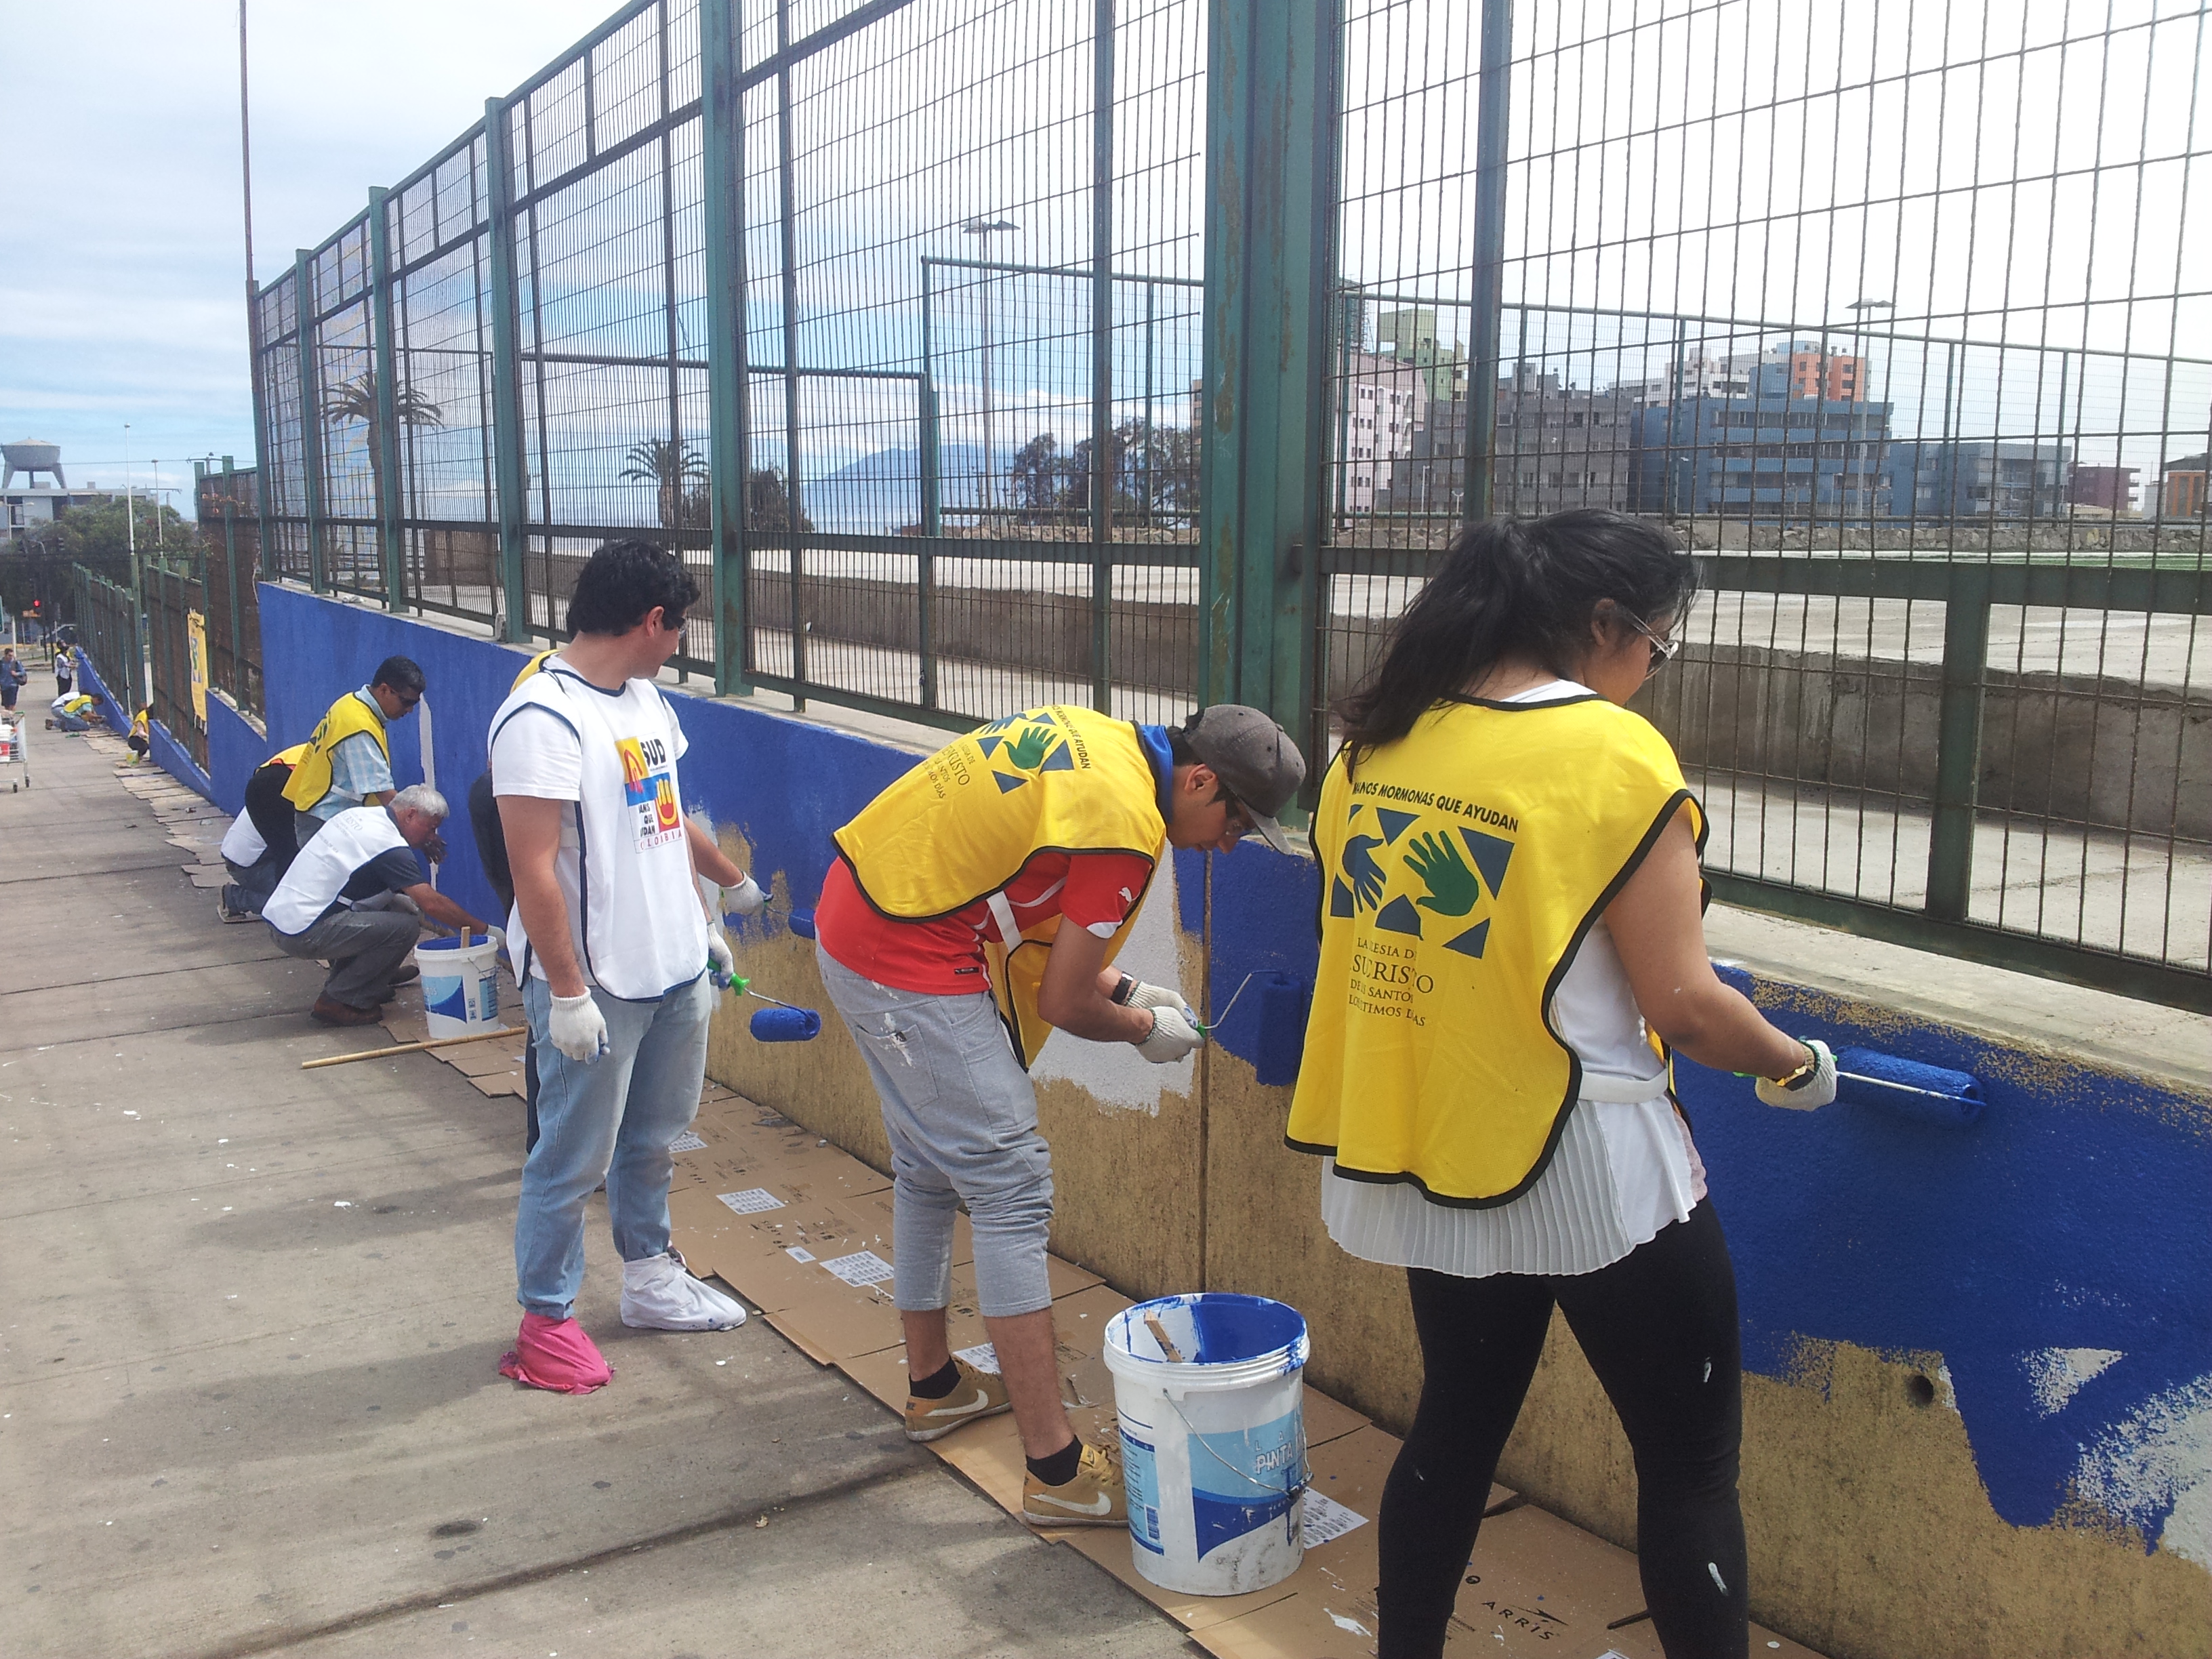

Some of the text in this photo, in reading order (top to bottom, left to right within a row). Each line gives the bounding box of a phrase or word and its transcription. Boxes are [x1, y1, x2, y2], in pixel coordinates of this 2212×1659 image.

[640, 739, 666, 767] SUD
[1073, 739, 1091, 769] AYUDAN
[934, 782, 946, 798] DÍAS
[1377, 783, 1435, 806] MORMONAS
[1436, 795, 1462, 814] QUE
[1462, 803, 1519, 833] AYUDAN
[1481, 1601, 1554, 1640] ARRIS
